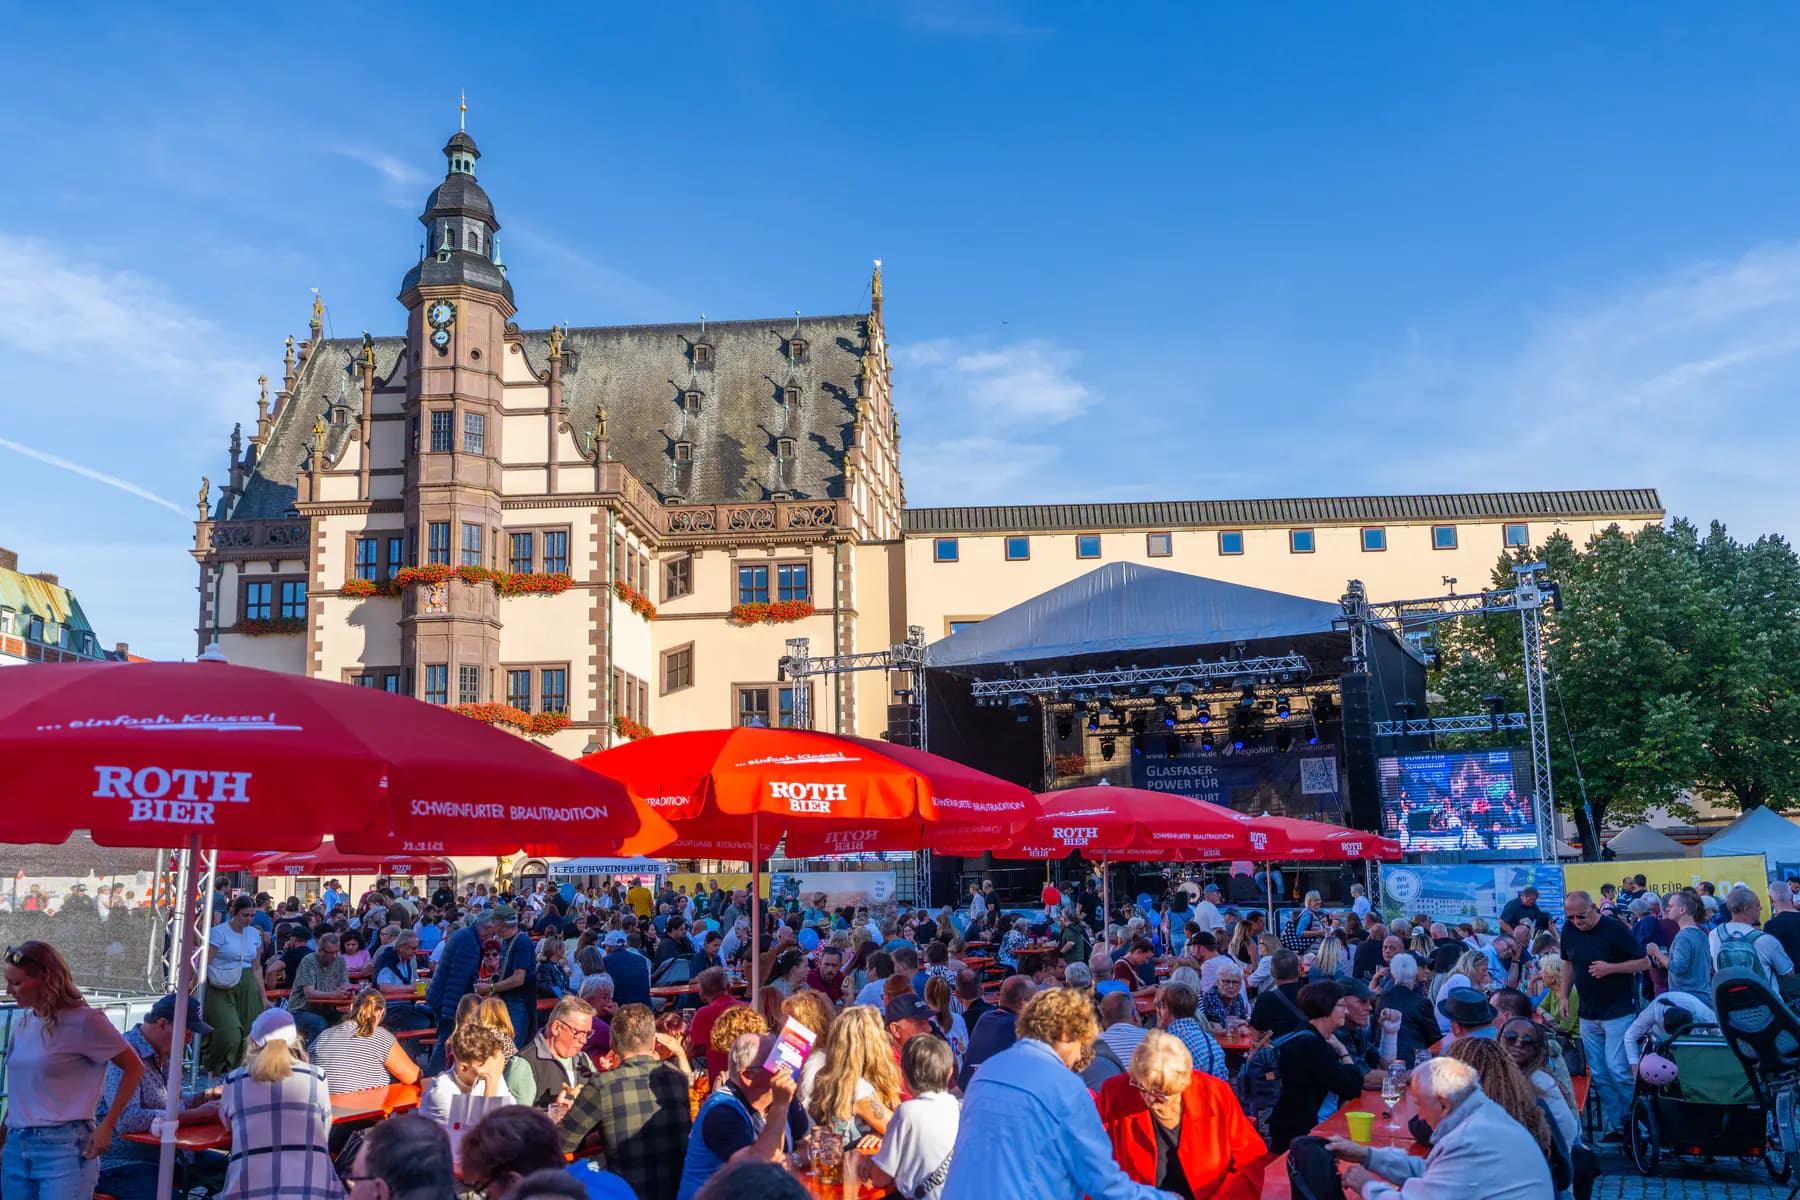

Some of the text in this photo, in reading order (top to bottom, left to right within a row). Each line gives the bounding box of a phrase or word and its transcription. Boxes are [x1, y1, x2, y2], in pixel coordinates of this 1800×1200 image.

[69, 714, 175, 729] einfach
[182, 713, 276, 723] Klasse!
[1146, 765, 1218, 777] GLASFASER-
[92, 765, 252, 802] ROTH
[1147, 776, 1219, 790] POWER FÜR
[769, 782, 847, 801] ROTH
[129, 800, 215, 824] BIER
[411, 800, 608, 822] SCHWEINFURTER BRAUTRADITION
[789, 800, 831, 813] BIER
[1052, 828, 1099, 838] ROTH
[1063, 838, 1088, 846] BIER
[554, 866, 561, 874] 1.
[564, 866, 575, 874] FC
[577, 864, 646, 873] SCHWEINFURT
[1662, 881, 1682, 894] FÜR
